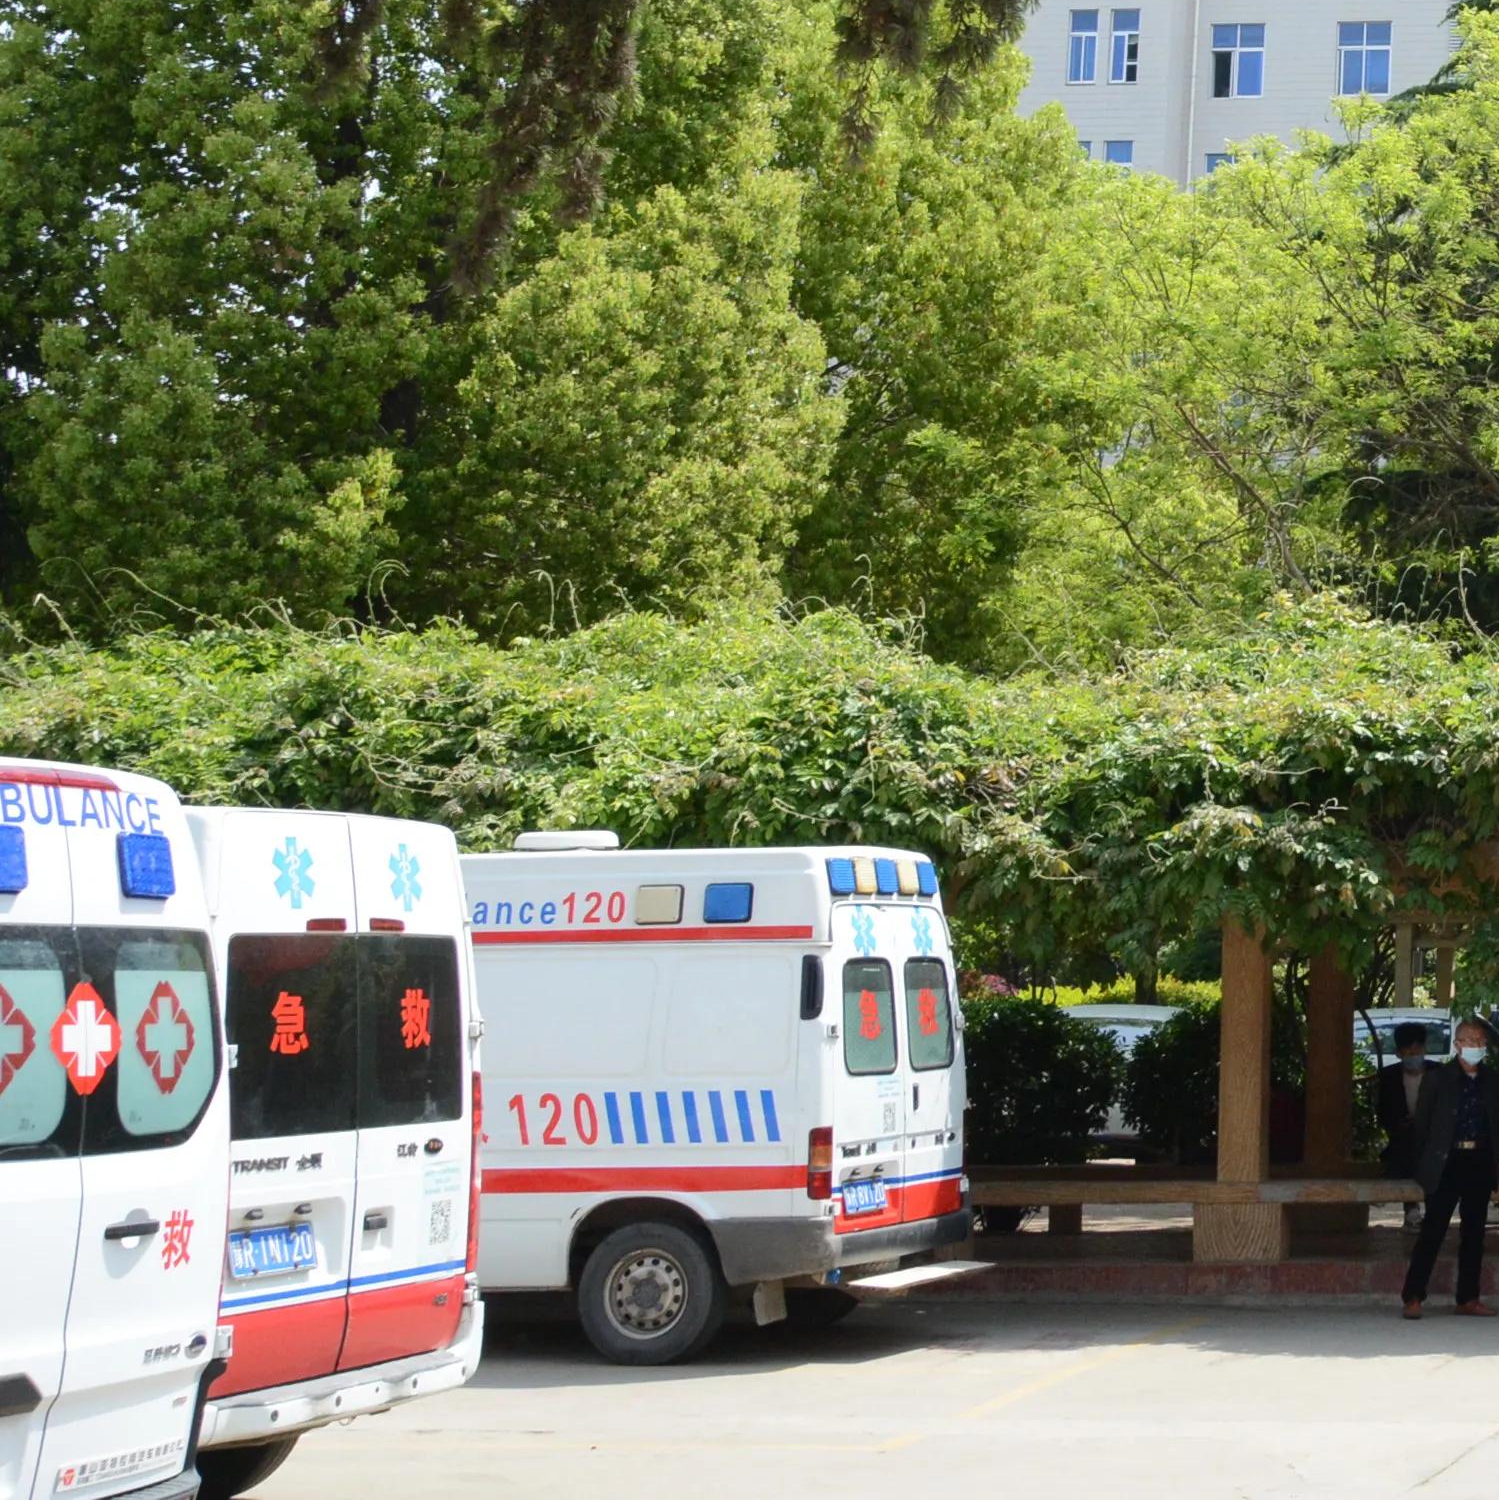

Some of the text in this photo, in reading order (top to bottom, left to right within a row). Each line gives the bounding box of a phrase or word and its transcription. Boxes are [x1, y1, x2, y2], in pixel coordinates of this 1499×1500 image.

[509, 1093, 598, 1145] 120
[232, 1156, 290, 1174] TRANSIT
[161, 1209, 195, 1270] 救
